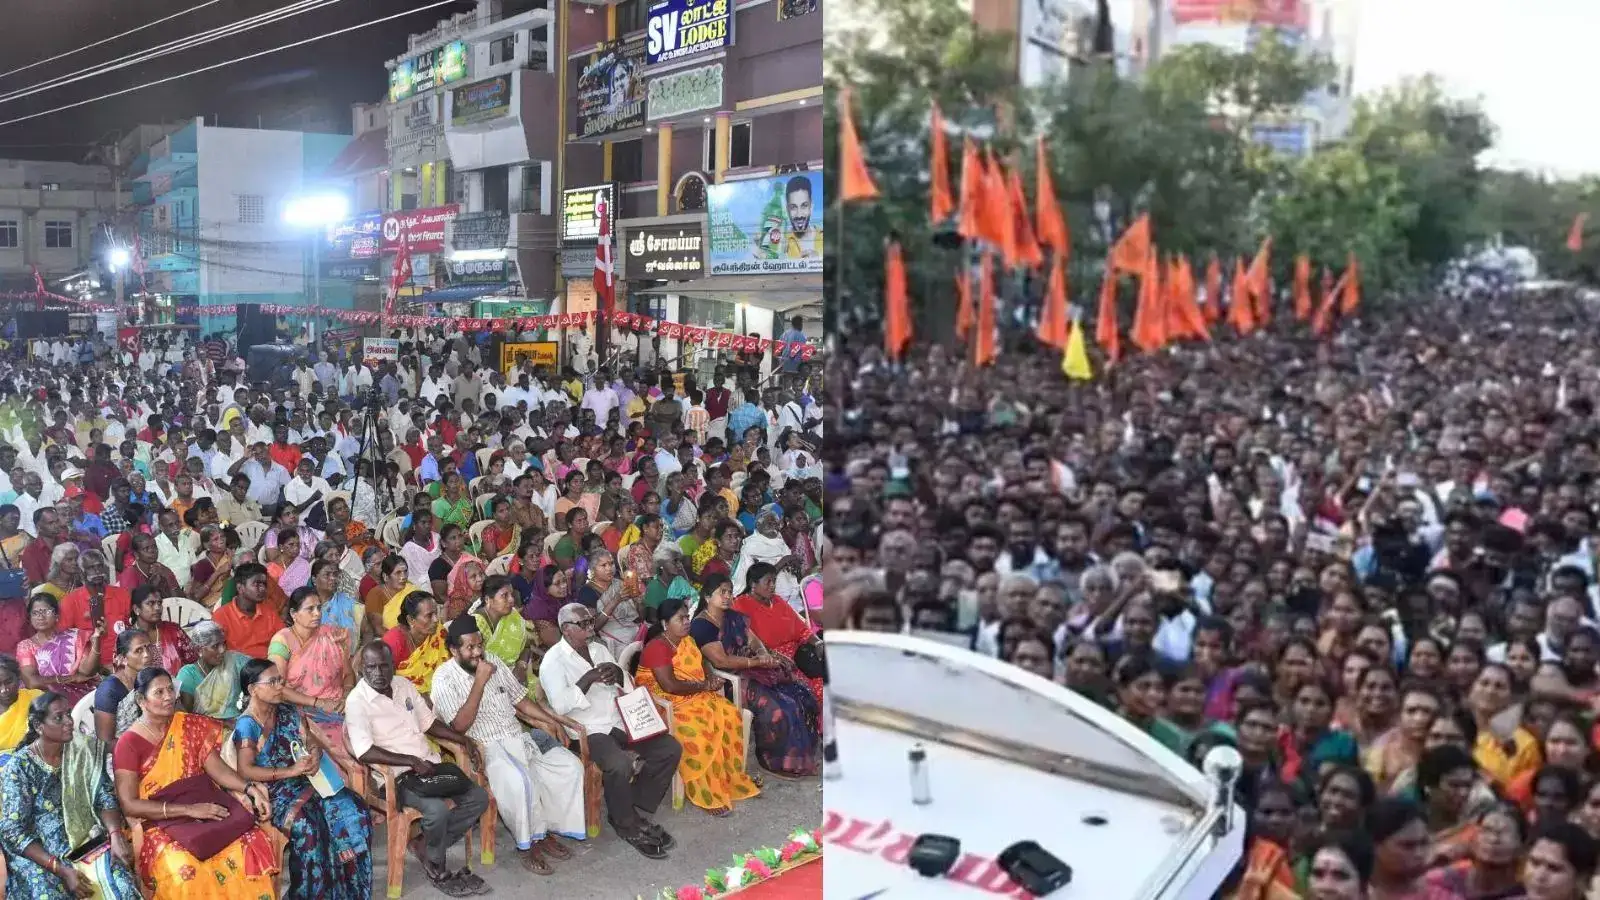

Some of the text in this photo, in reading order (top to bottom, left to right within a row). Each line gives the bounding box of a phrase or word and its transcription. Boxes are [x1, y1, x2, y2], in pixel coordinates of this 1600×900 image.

[648, 11, 679, 55] SV
[680, 17, 727, 48] LODGE
[630, 231, 645, 256] ஸ்ரீ
[647, 230, 701, 251] சோமப்பா
